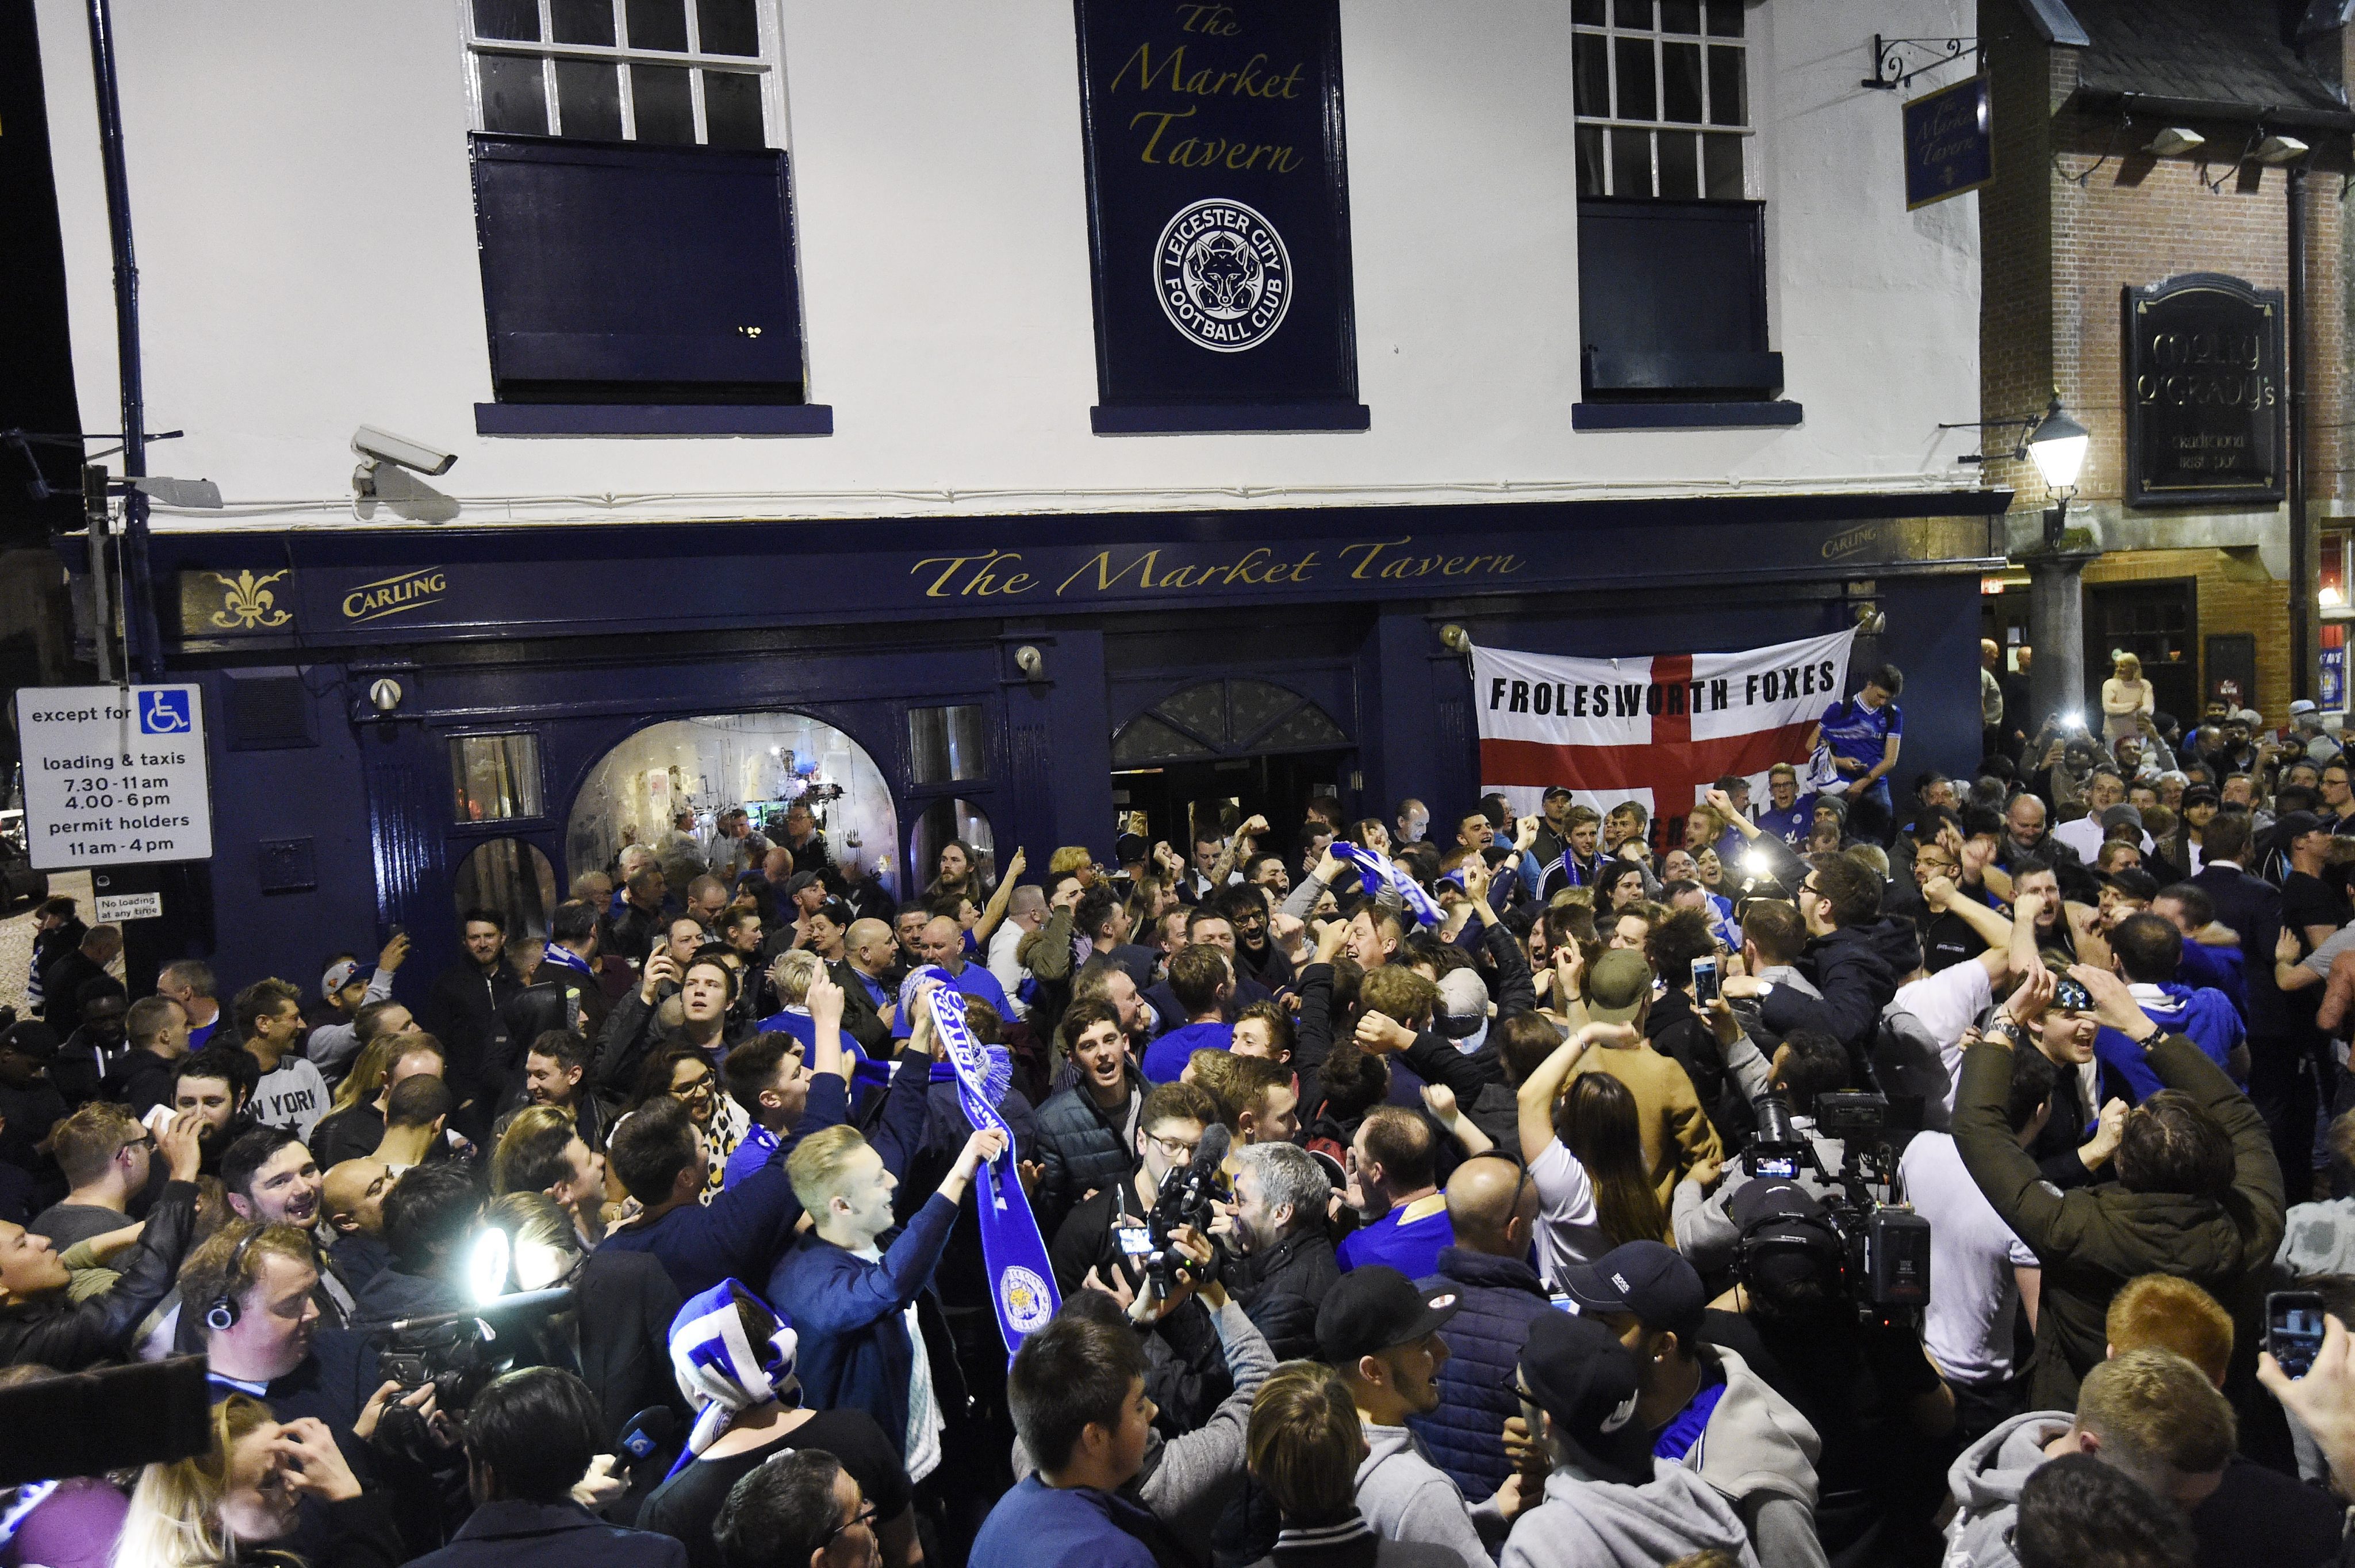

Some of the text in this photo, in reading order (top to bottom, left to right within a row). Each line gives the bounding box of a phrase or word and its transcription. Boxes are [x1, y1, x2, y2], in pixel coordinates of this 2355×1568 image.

[1176, 3, 1242, 36] The
[1110, 42, 1305, 99] Market
[1129, 105, 1304, 173] Tavern
[1165, 208, 1281, 270] LEICESTER CITY
[1164, 278, 1282, 342] FOOTBALL CLUB
[1821, 528, 1877, 559] CARLING
[910, 535, 1526, 598] The Market Tavern
[342, 573, 446, 618] CARLING
[1490, 660, 1835, 718] FROLESWORTH FOXES
[32, 706, 131, 723] except for
[43, 751, 186, 770] loading & taxis
[49, 815, 190, 836] permit holders
[102, 897, 155, 908] No loading
[135, 907, 157, 915] time
[946, 1023, 975, 1065] CITY
[1613, 1272, 1630, 1291] BOSS
